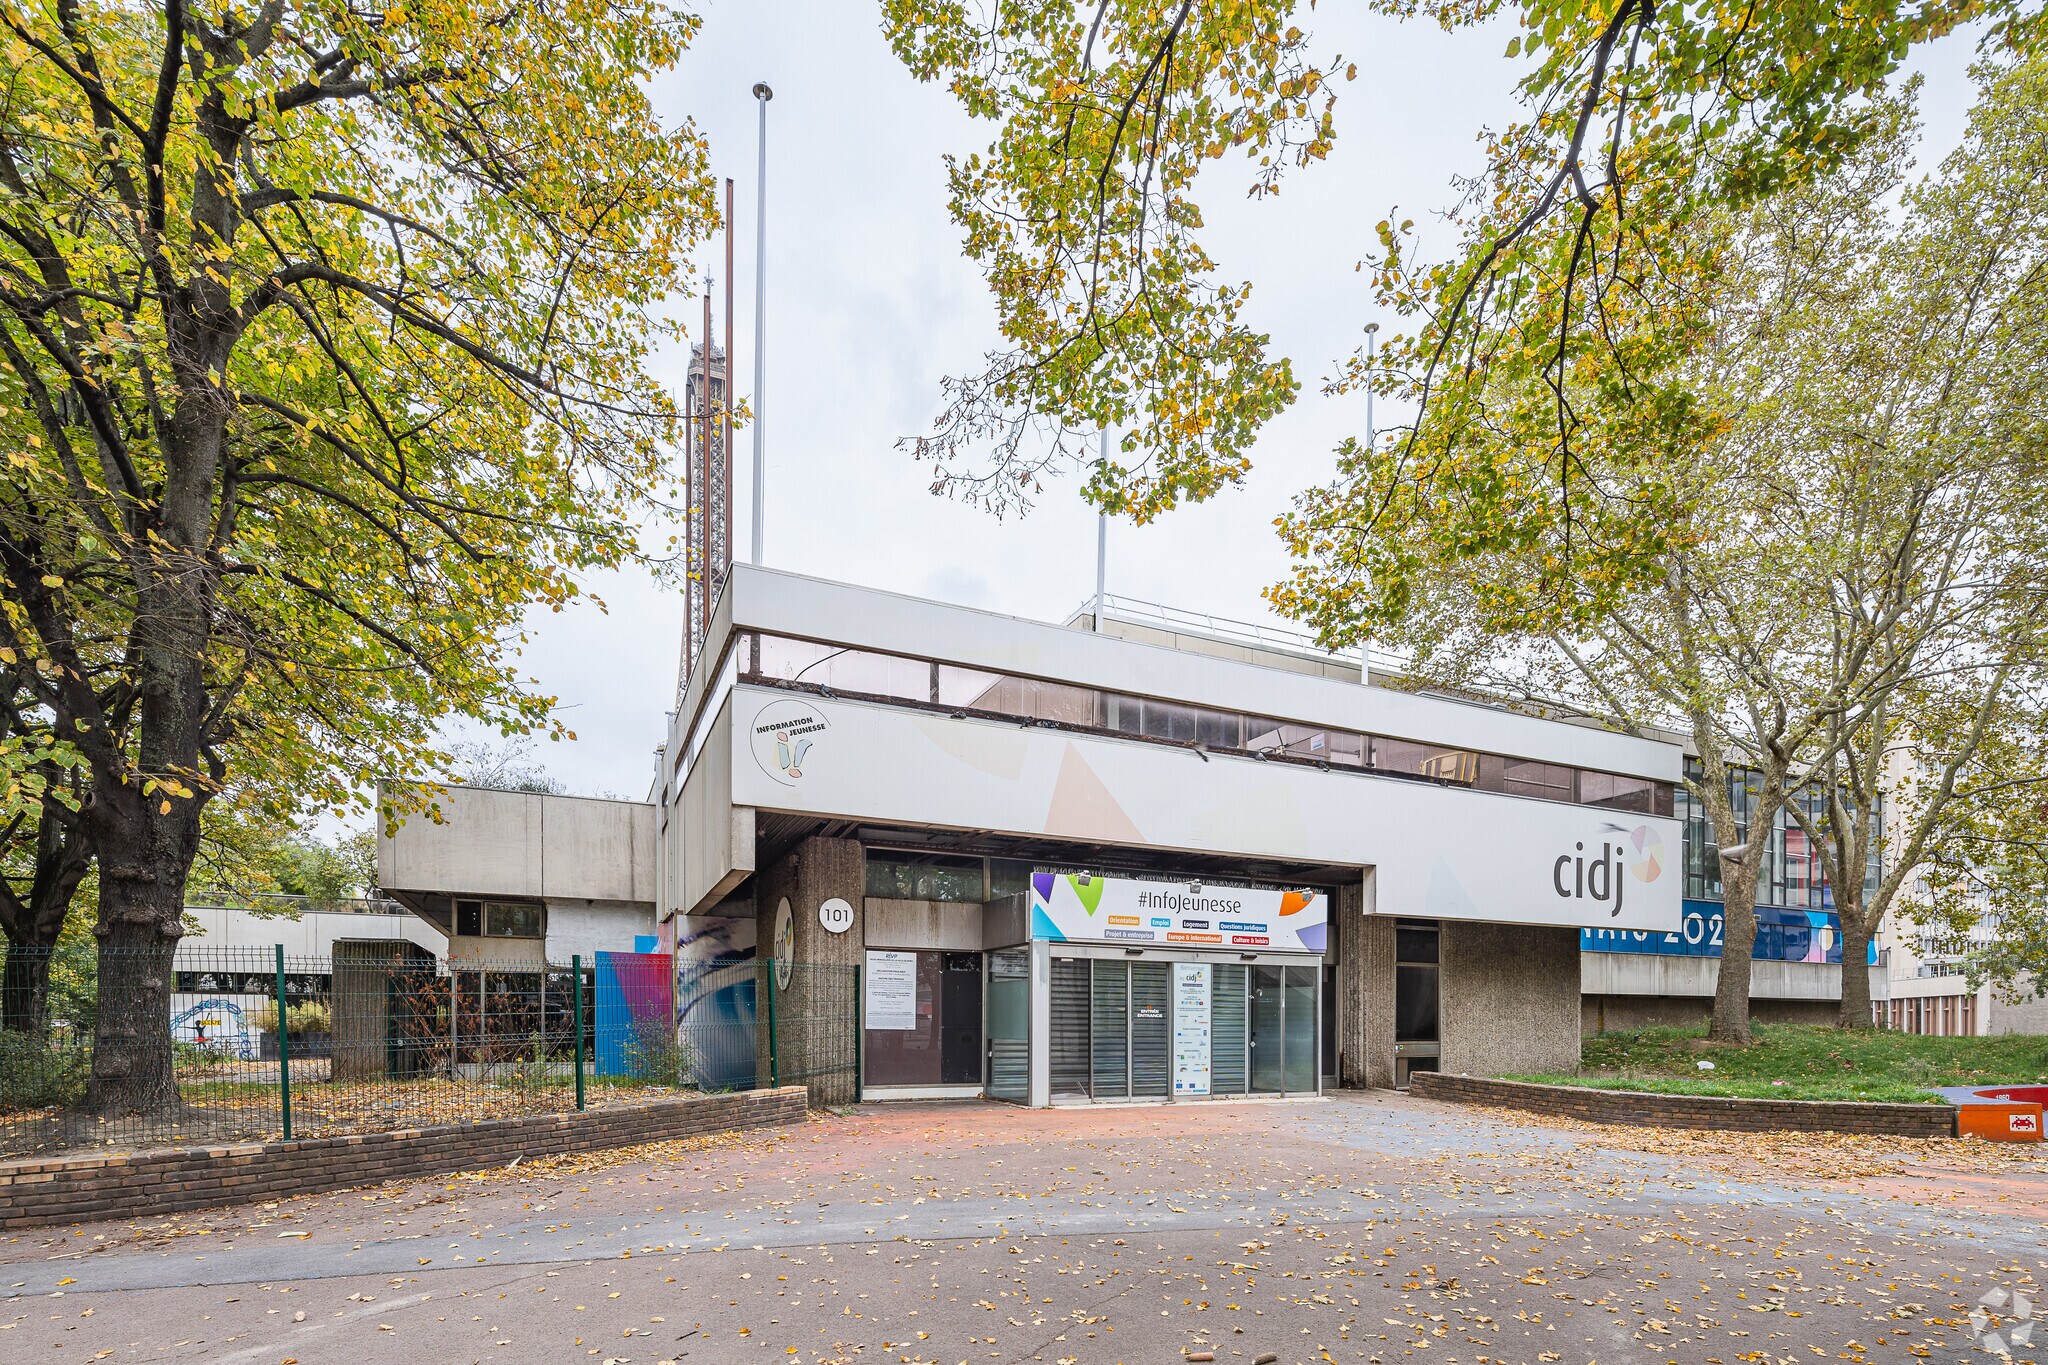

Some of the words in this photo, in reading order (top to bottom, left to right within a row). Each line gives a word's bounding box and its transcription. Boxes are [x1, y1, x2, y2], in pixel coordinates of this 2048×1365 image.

[756, 717, 813, 734] INFORMATION
[789, 723, 826, 736] JEUNESSE
[1553, 841, 1624, 918] cidj
[1138, 890, 1242, 914] #InfoJeunesse
[825, 908, 849, 922] 101
[1109, 916, 1139, 925] Orientation
[1152, 918, 1170, 927] Emploi
[1183, 920, 1208, 929] Logement
[1220, 922, 1243, 930] Questions
[1243, 923, 1267, 932] juridiques
[1105, 930, 1122, 939] Projet
[1127, 931, 1154, 940] entreprise
[1167, 933, 1185, 942] Europe
[1190, 934, 1222, 942] international
[1233, 936, 1250, 944] Culture
